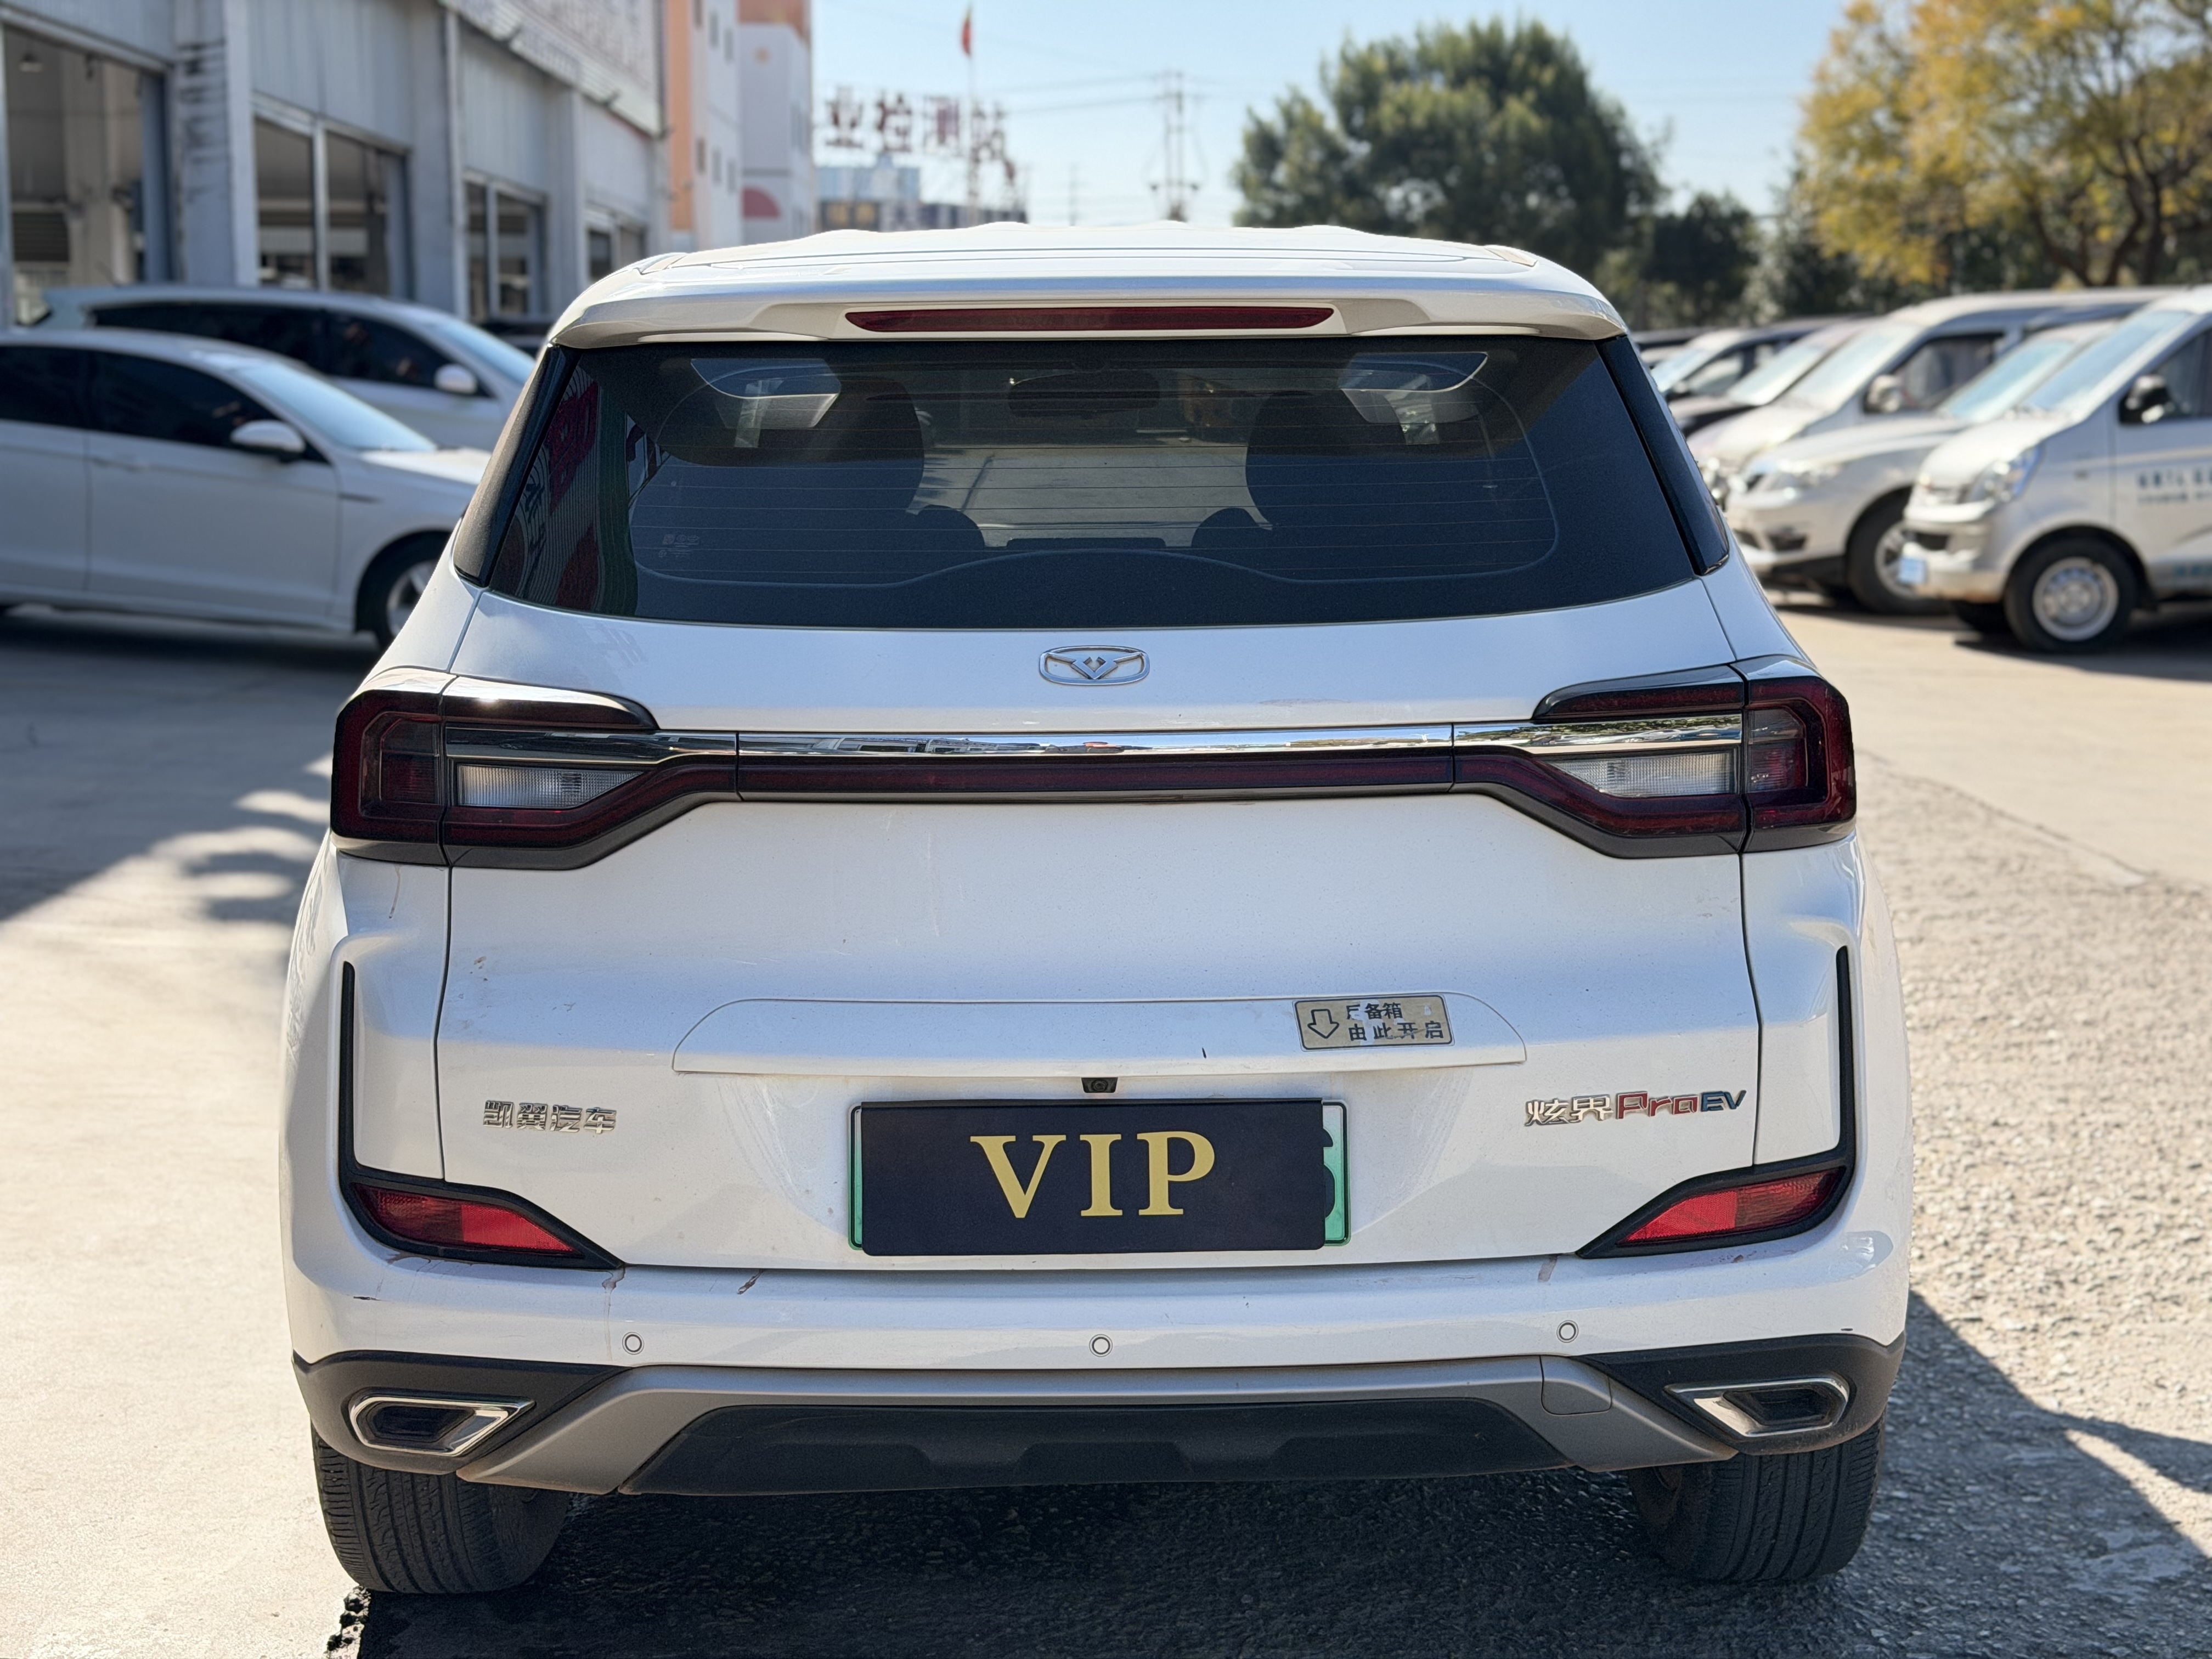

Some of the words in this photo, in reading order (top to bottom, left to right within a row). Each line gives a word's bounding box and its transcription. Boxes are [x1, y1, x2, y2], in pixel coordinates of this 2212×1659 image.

[1348, 1020, 1444, 1041] 由此开启
[483, 1100, 617, 1134] 凯翼汽车
[970, 1131, 1215, 1219] VIP
